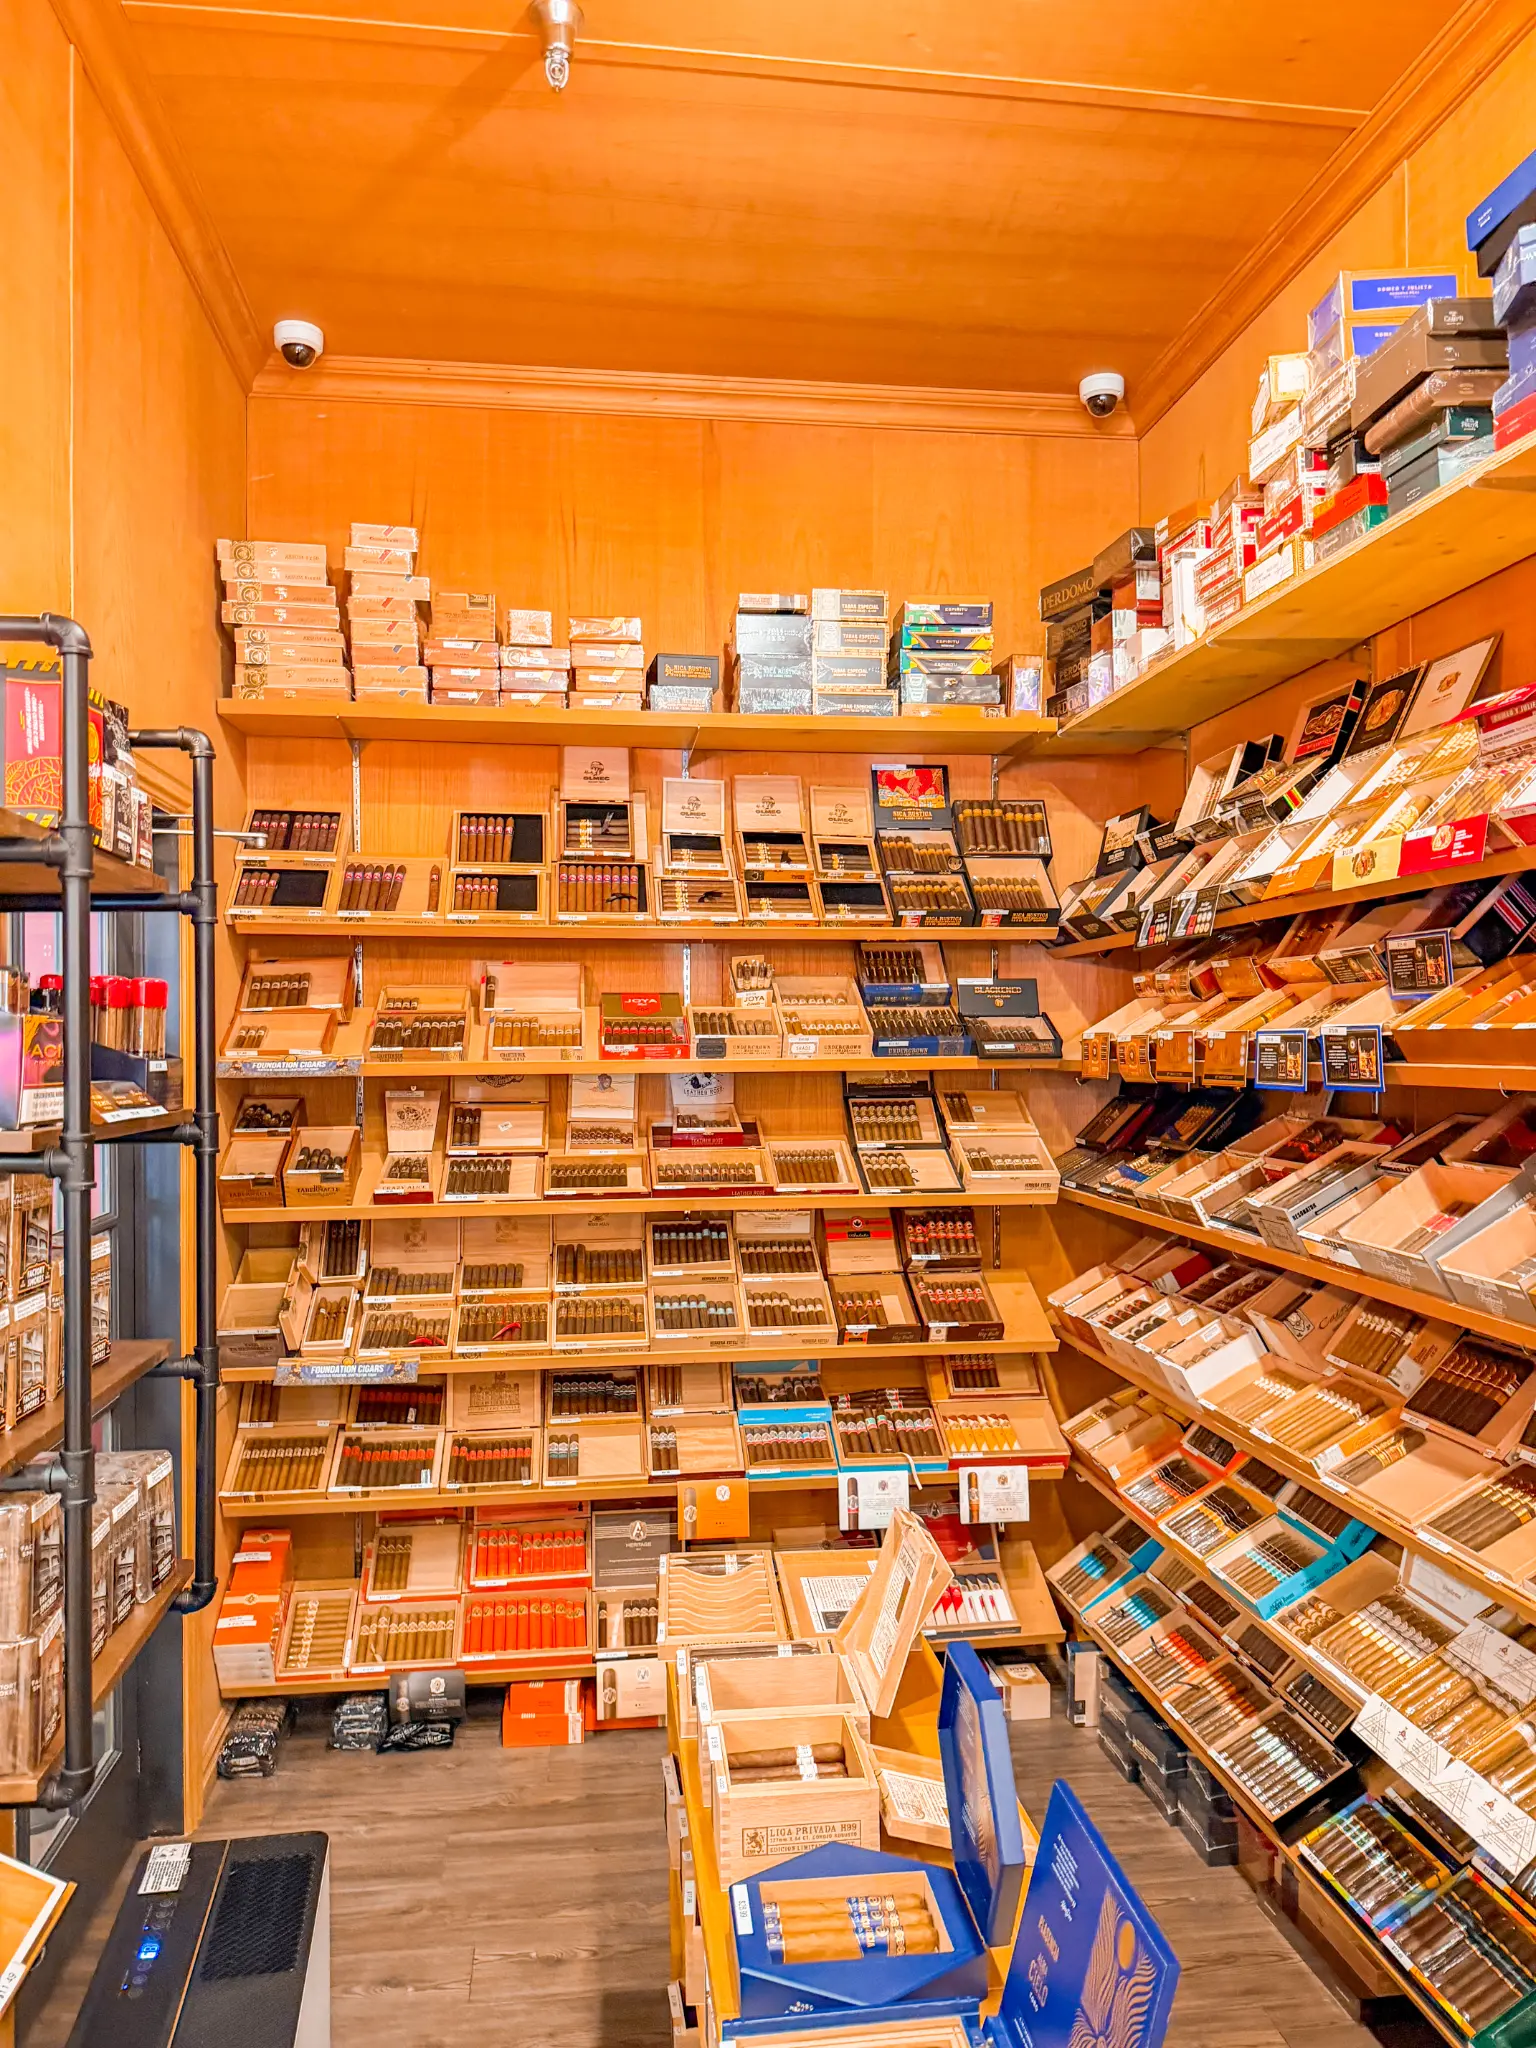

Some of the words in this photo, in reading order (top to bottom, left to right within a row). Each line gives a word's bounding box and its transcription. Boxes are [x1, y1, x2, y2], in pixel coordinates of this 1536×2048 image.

[1043, 576, 1094, 611] PERDOMO
[673, 666, 686, 674] NICA
[687, 666, 712, 674] RUSTICA
[974, 986, 1022, 994] BLACKENED
[252, 1061, 298, 1069] FOUNDATION
[299, 1060, 327, 1068] CIGARS
[27, 1265, 45, 1281] FACTORY
[27, 1274, 45, 1288] SMOKES
[311, 1365, 357, 1373] FOUNDATION
[358, 1364, 384, 1373] CIGARS
[23, 1388, 41, 1404] FACTORY
[23, 1398, 40, 1413] SMOKES
[770, 1828, 793, 1838] LIGA
[796, 1825, 836, 1836] PRIVADA
[840, 1823, 857, 1832] H99
